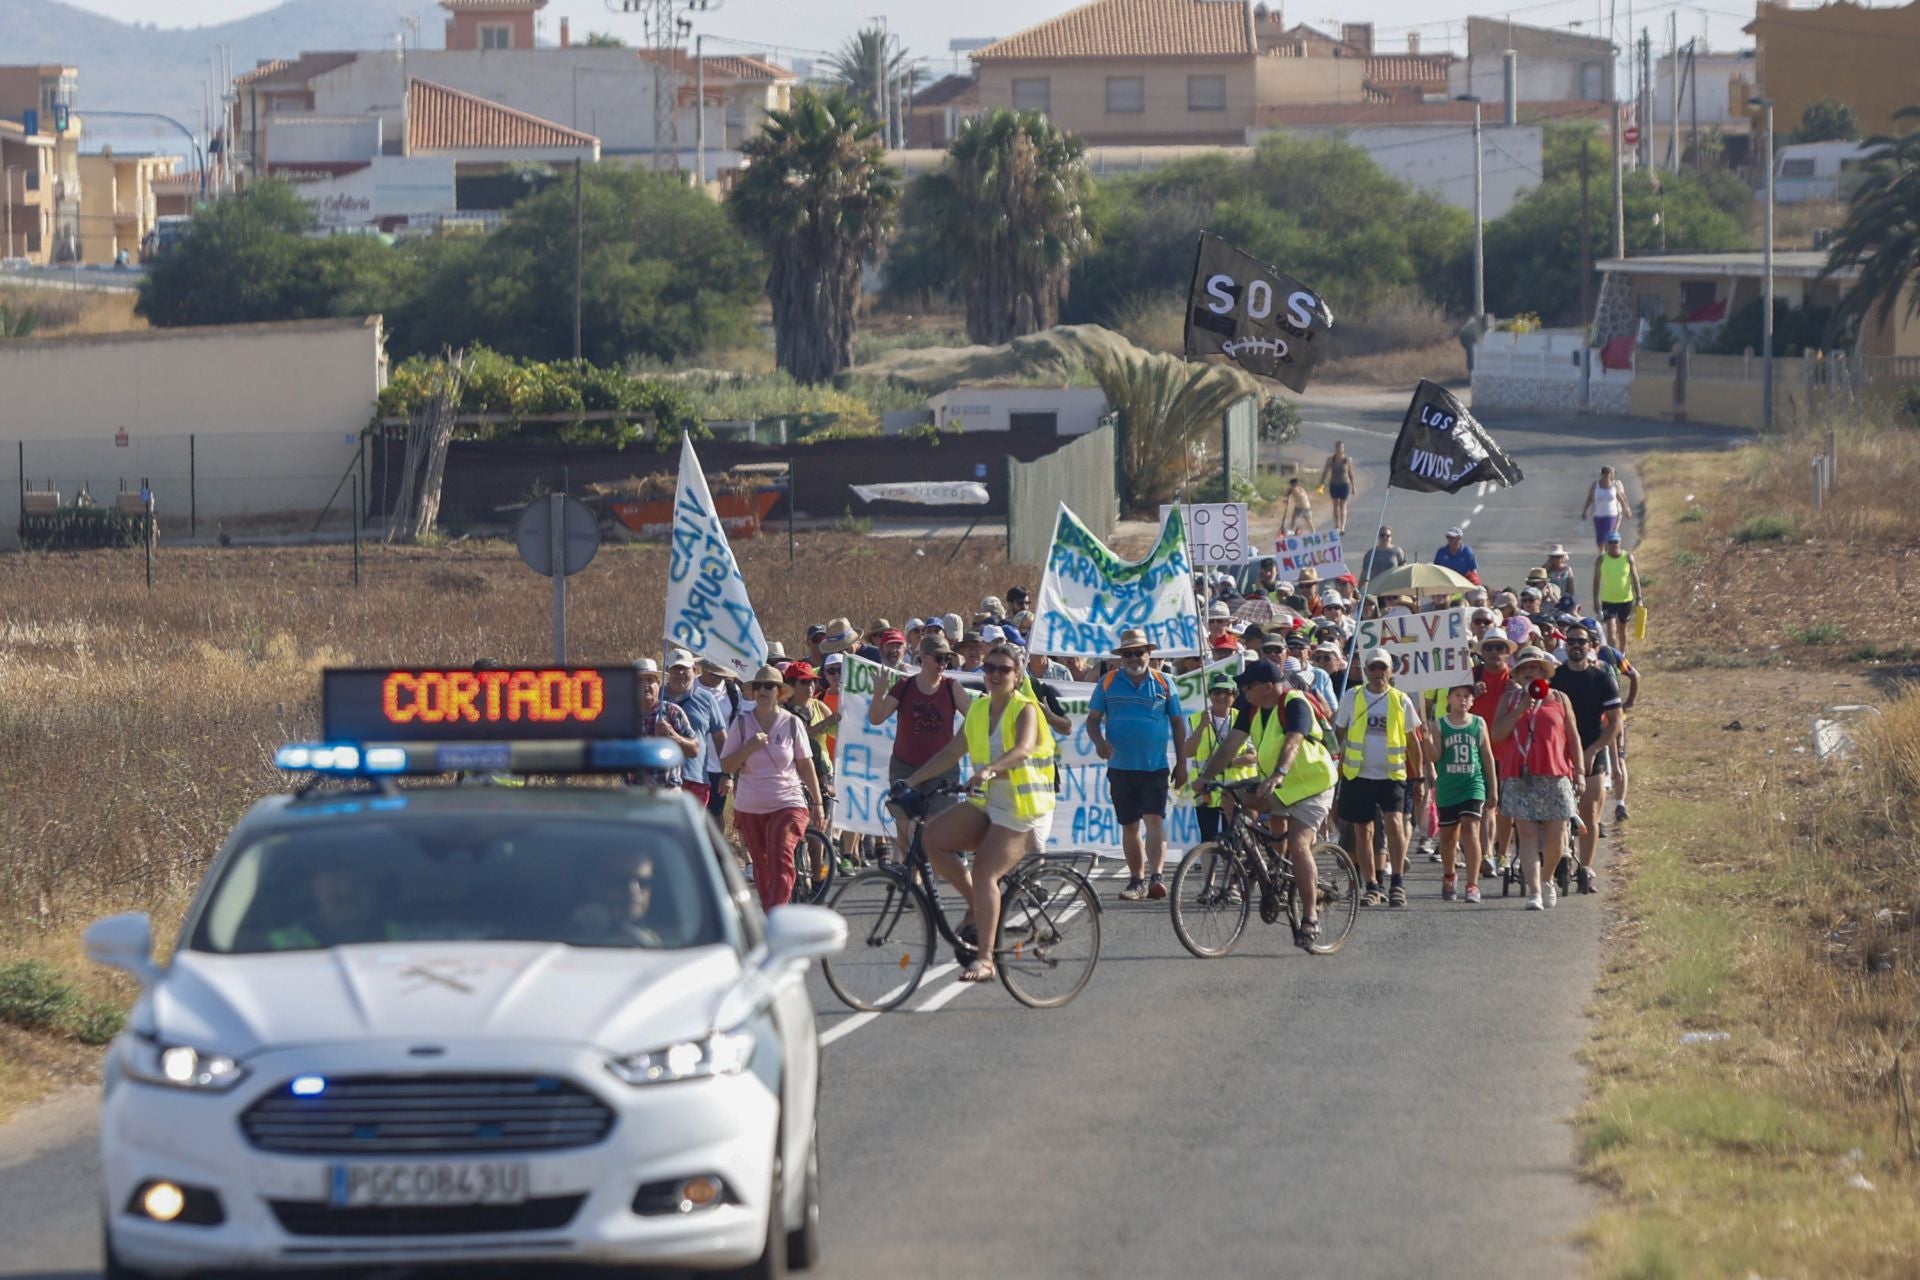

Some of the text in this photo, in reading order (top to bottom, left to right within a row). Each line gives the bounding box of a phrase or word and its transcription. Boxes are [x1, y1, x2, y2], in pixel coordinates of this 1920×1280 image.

[1206, 274, 1316, 329] SOS
[1421, 406, 1453, 430] LOS
[1409, 449, 1453, 481] VIVOS
[1275, 537, 1298, 553] NO
[1283, 545, 1342, 572] NEGLECT!
[1048, 543, 1099, 591] PARA
[1088, 592, 1155, 625] NO
[1044, 610, 1115, 654] PARA
[382, 670, 604, 723] CORTADO
[1453, 744, 1470, 763] 19
